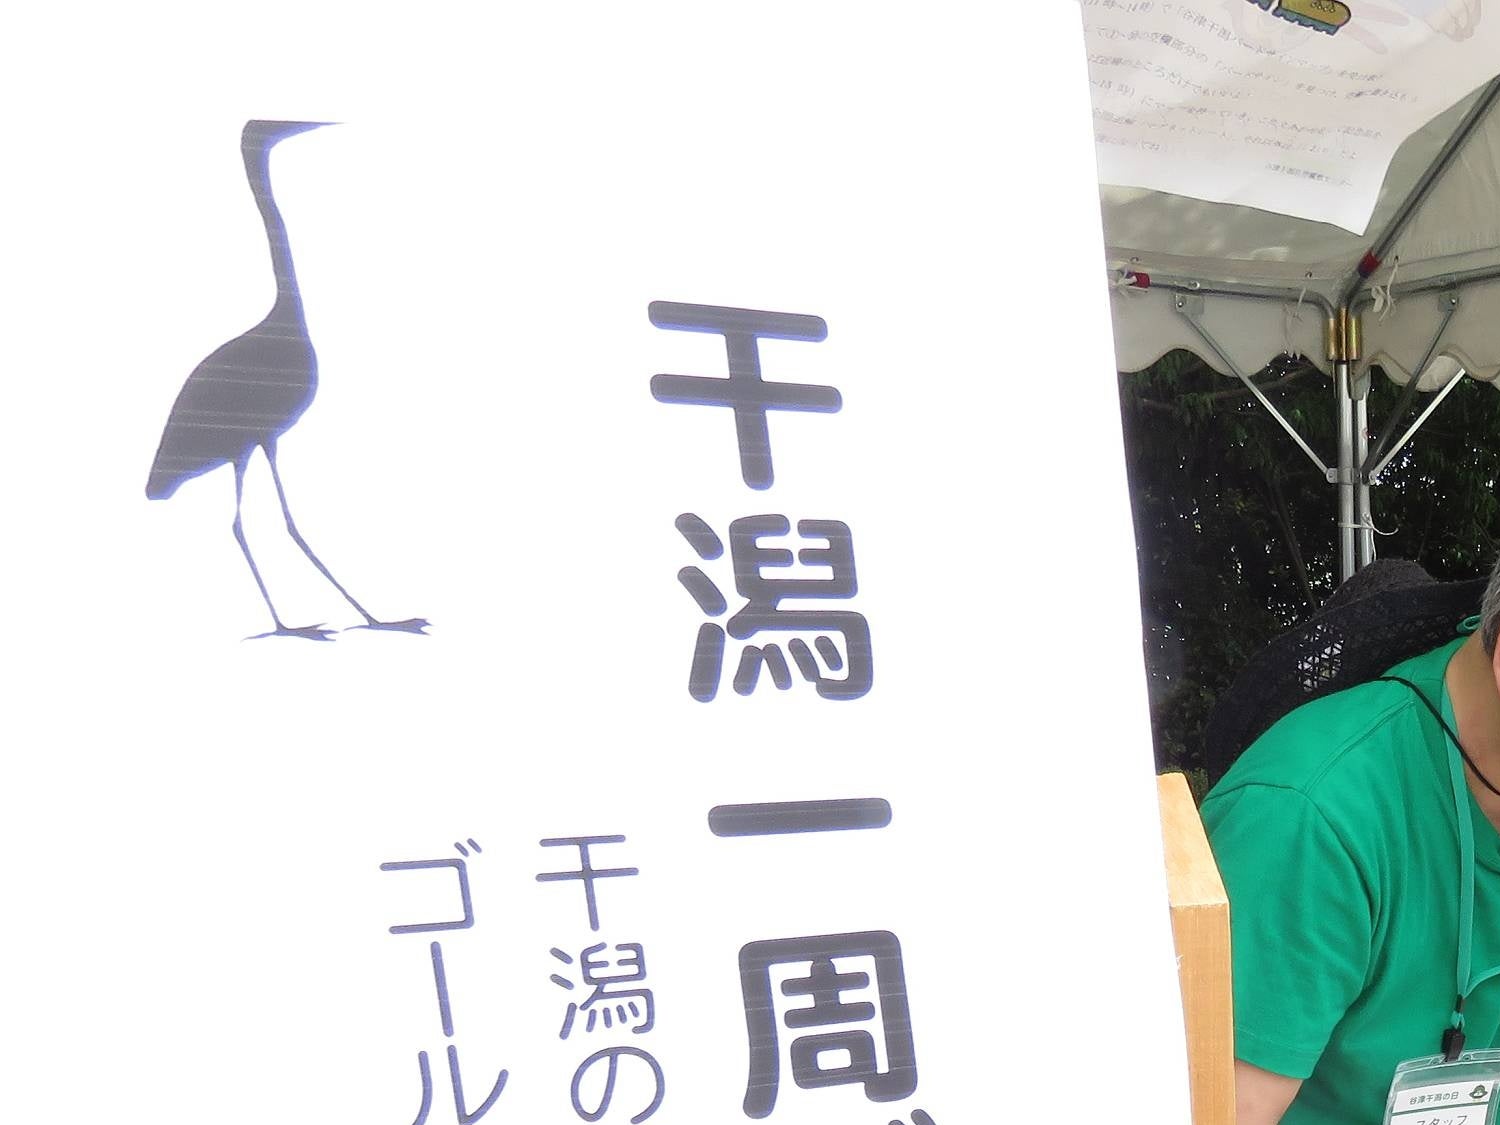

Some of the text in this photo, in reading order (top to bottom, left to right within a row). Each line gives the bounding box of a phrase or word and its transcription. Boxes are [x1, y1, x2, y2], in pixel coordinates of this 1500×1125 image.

[1409, 1091, 1460, 1105] 谷津干潟の日
